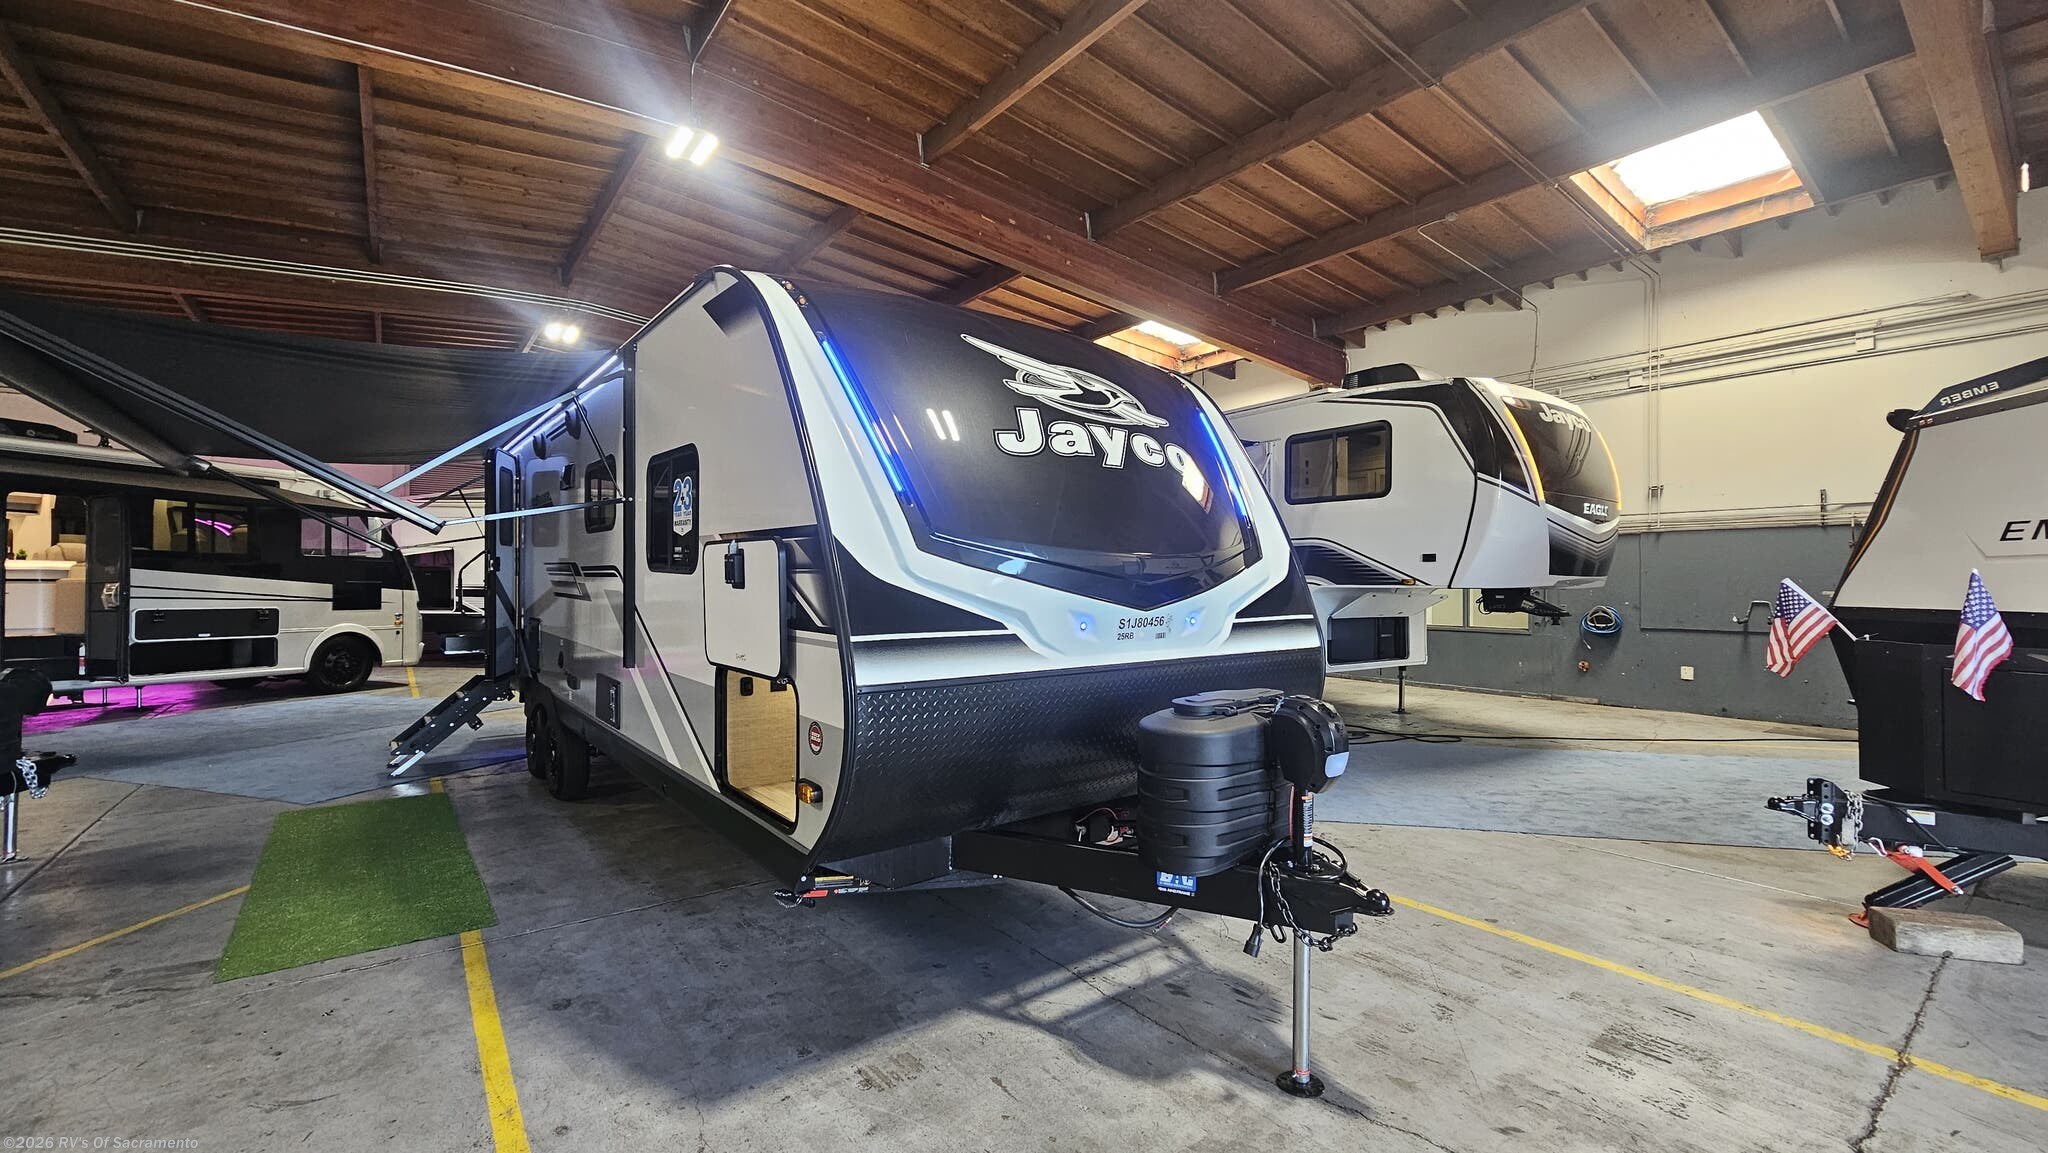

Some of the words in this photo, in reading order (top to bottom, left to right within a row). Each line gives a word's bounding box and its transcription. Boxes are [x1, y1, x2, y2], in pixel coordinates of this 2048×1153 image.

[1538, 403, 1592, 432] Jayco
[993, 407, 1191, 474] Jayco
[1583, 502, 1609, 517] EAGLE
[1118, 616, 1165, 630] S1J80456
